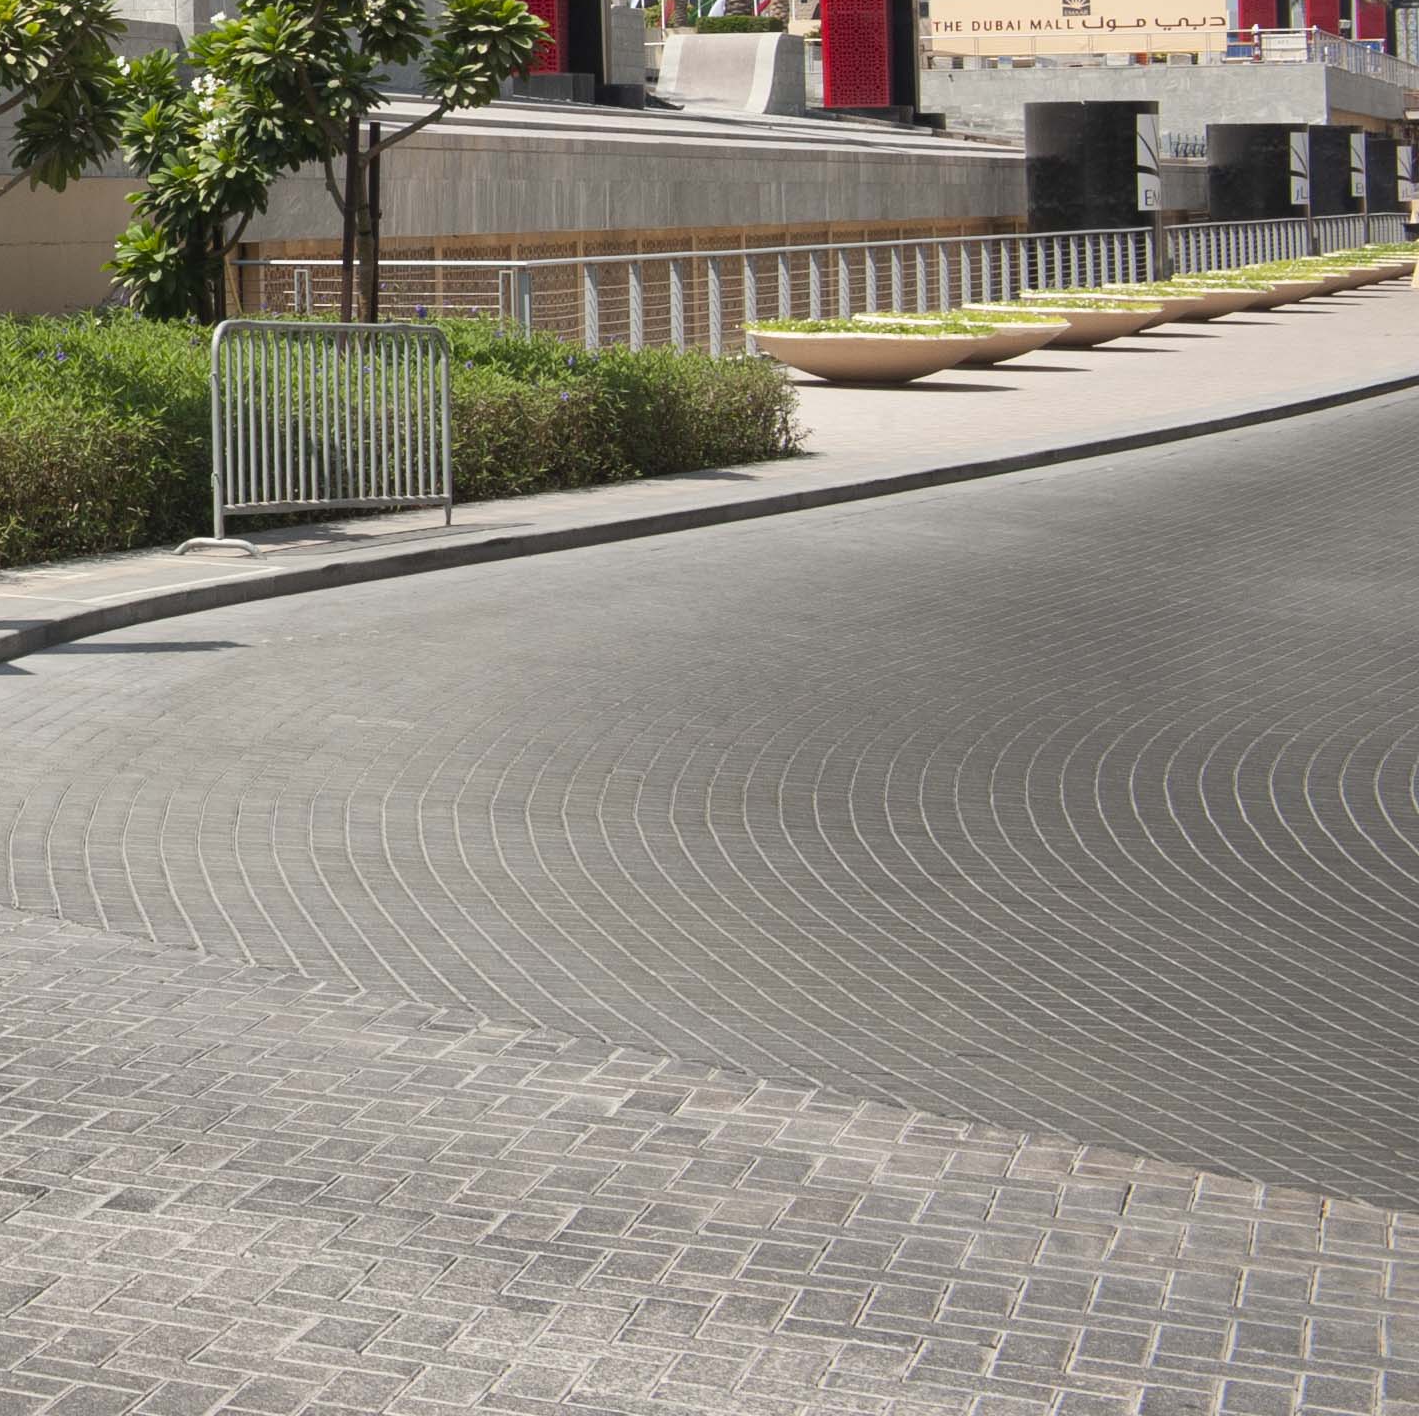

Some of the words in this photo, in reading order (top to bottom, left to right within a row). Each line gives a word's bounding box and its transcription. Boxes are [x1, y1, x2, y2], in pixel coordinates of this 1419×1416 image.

[933, 21, 963, 32] THE
[971, 19, 1021, 31] DUBAI
[1030, 17, 1074, 30] MALL
